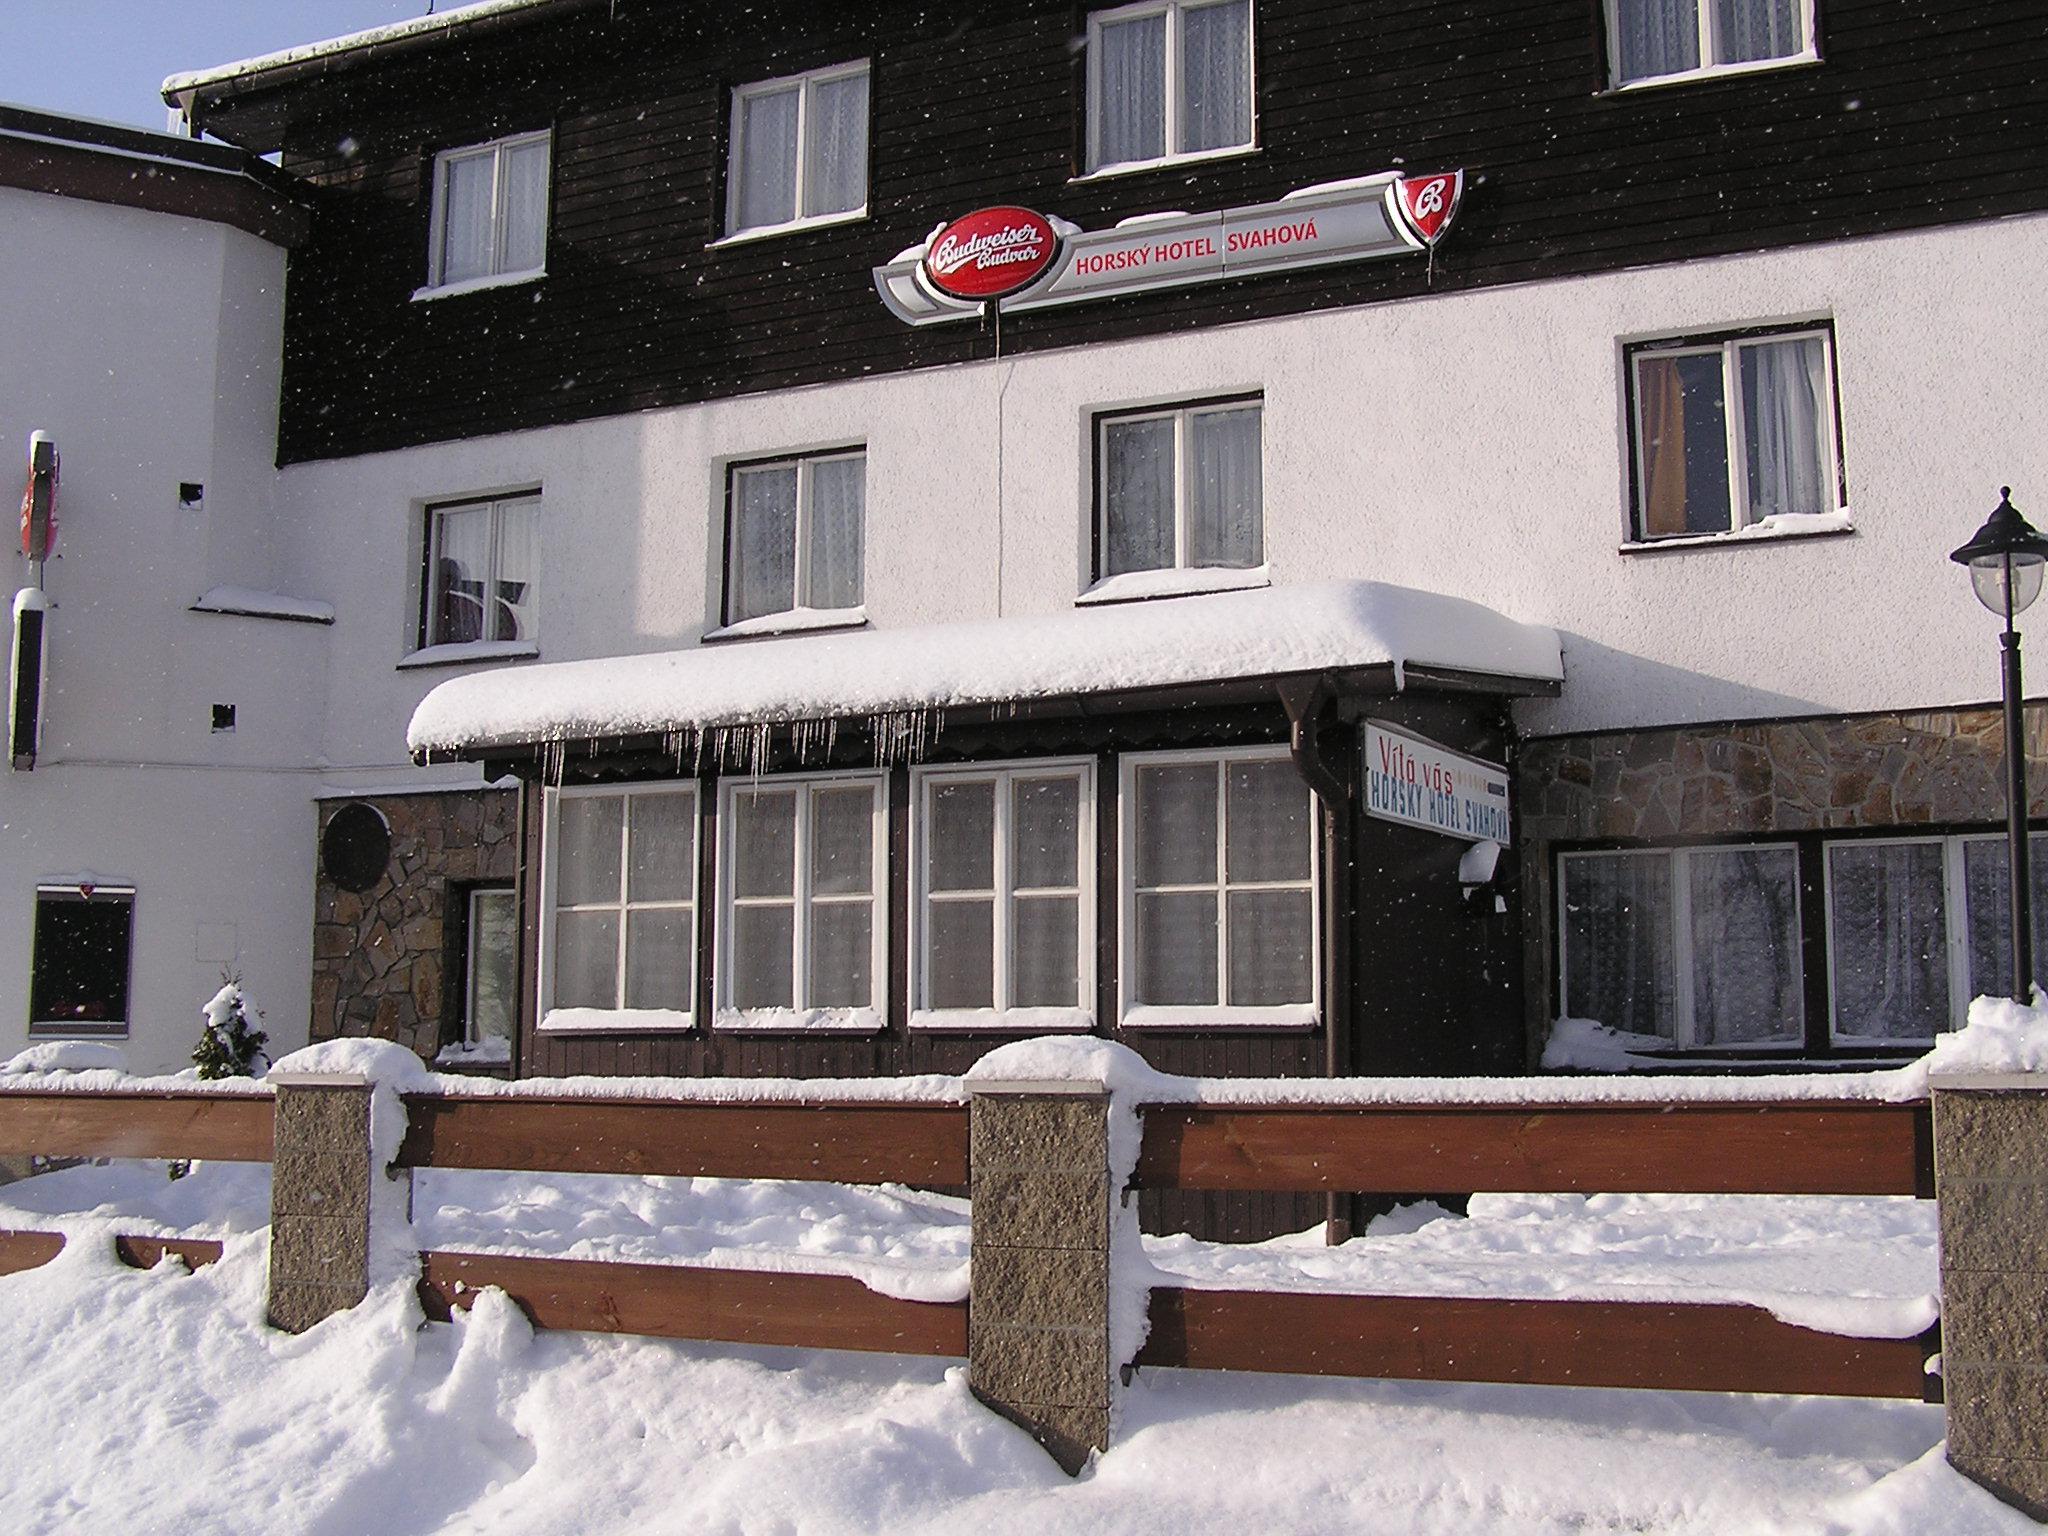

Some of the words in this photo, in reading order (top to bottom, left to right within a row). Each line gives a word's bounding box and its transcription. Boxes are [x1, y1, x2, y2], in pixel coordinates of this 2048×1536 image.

[934, 223, 1044, 274] Budweiser
[976, 246, 1041, 270] Budvar
[1076, 243, 1151, 276] HORSKÝ
[1154, 237, 1217, 263] HOTEL
[1227, 216, 1318, 252] SVAHOVÁ
[1379, 735, 1415, 784] Vítá
[1422, 762, 1453, 795] vás
[1428, 787, 1461, 830] HOTEL
